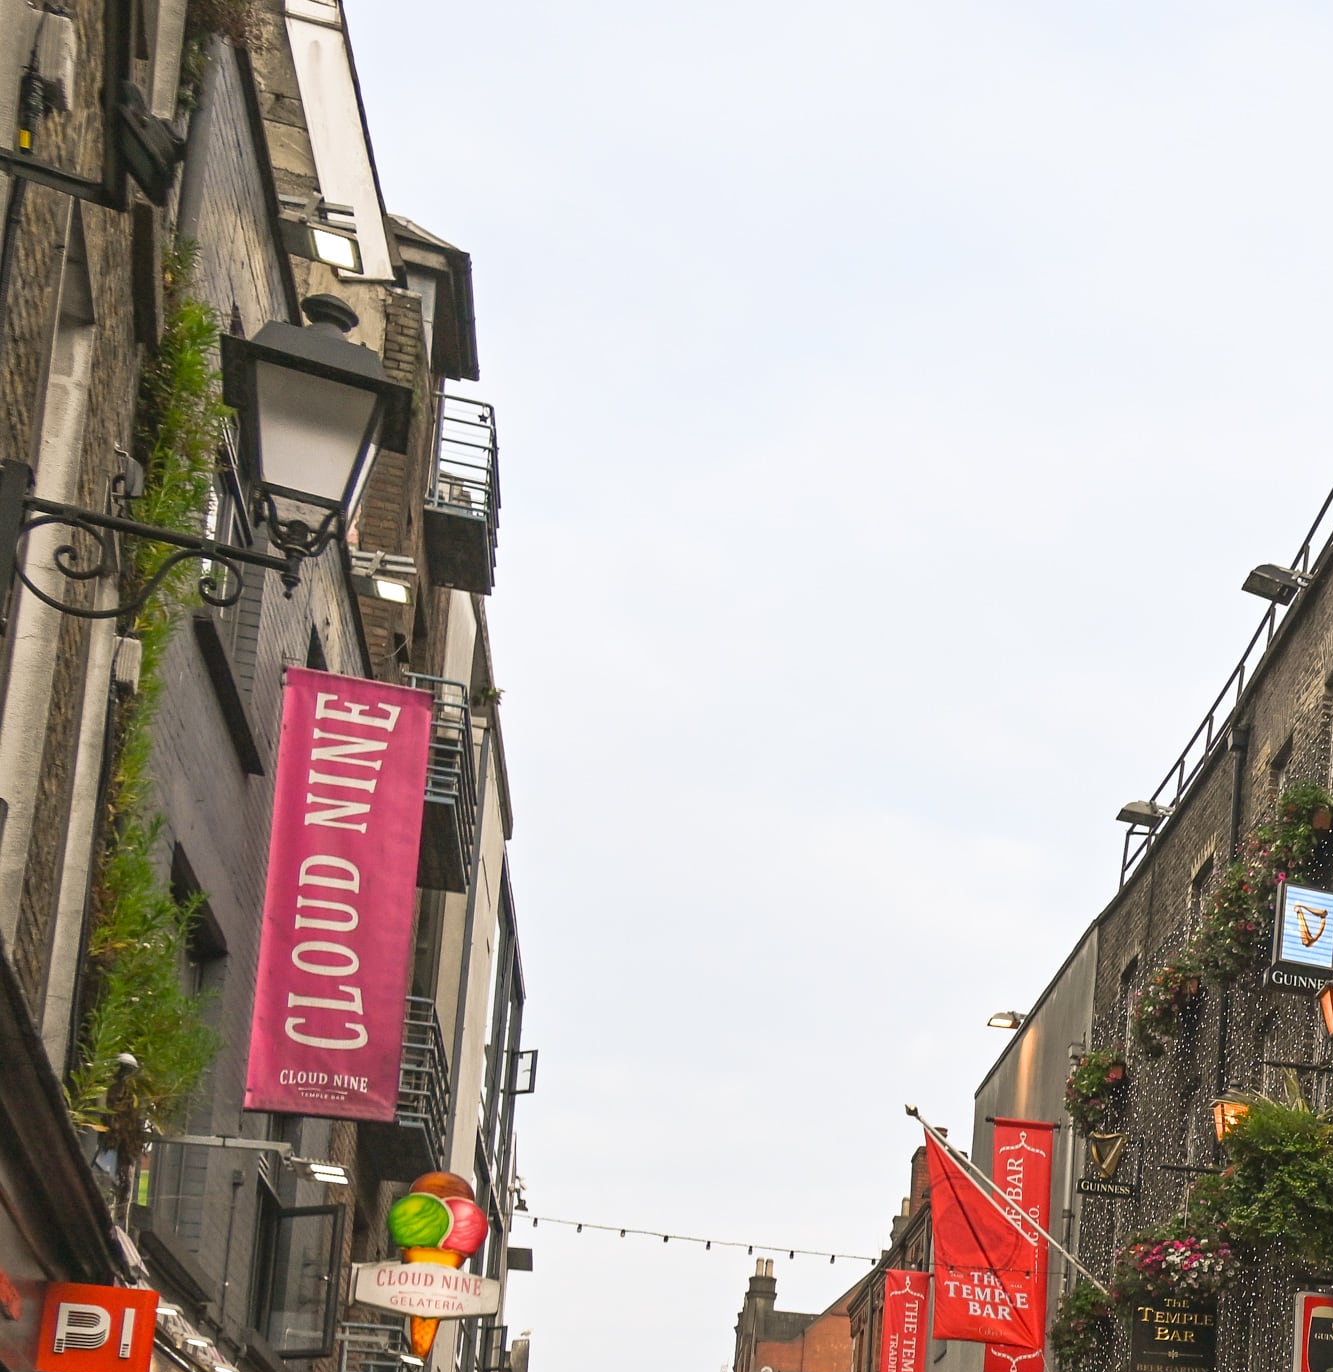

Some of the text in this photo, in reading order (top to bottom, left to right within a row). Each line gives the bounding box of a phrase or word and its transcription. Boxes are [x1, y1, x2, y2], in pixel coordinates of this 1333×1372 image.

[284, 691, 402, 1052] CLOUD NINE
[1272, 970, 1325, 990] GUINNE
[279, 1069, 368, 1093] CLOUD NINE
[1006, 1157, 1024, 1201] BAR
[1081, 1180, 1130, 1194] GUINNESS
[376, 1268, 483, 1297] CLOUD NINE
[390, 1295, 464, 1313] GELATERIA
[944, 1281, 1029, 1309] TEMPLE
[1164, 1298, 1190, 1309] THE
[904, 1300, 919, 1333] THE
[968, 1301, 1012, 1321] BAR
[1137, 1306, 1214, 1327] TEMPLE
[54, 1302, 136, 1359] PI
[1154, 1326, 1196, 1343] BAR
